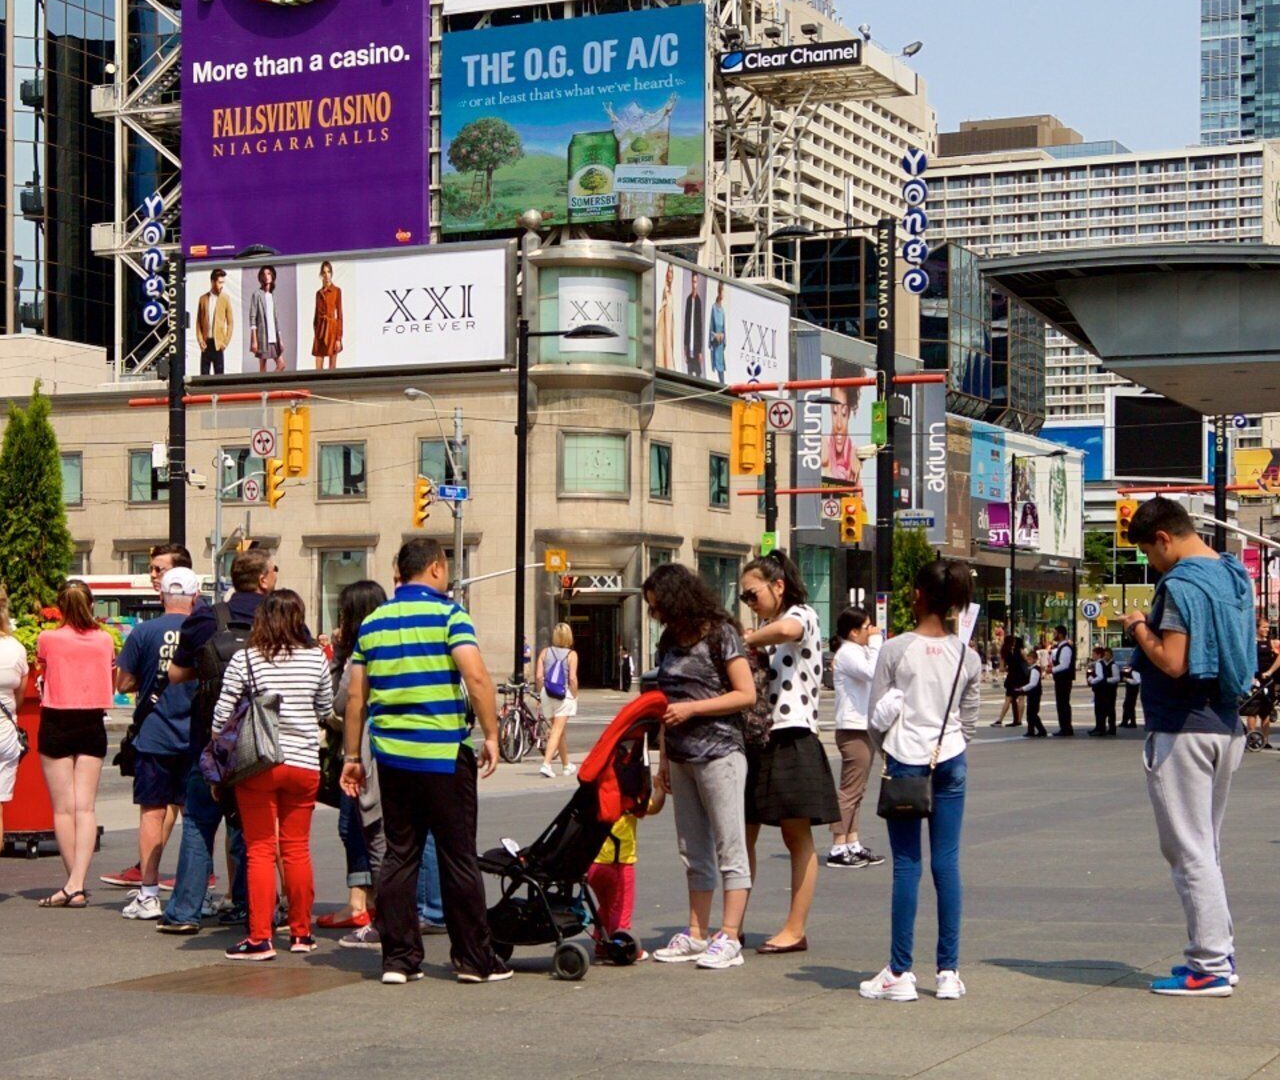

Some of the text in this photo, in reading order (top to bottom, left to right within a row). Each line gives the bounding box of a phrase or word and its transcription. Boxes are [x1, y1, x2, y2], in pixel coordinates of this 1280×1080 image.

[192, 42, 411, 83] More than a casino.
[461, 32, 679, 88] THE O.G. OF A/C
[745, 43, 858, 69] Clear Channel
[469, 73, 673, 108] or at least that's what we've heard
[212, 91, 392, 138] FALLSVIEW CASINO
[213, 127, 390, 157] NIAGARA FALLS
[571, 194, 617, 208] SOMERSBY
[878, 228, 889, 330] DOWNTOWN
[169, 261, 177, 354] DOWNTOWN
[384, 284, 475, 324] XXI
[382, 320, 476, 336] FOREVER
[741, 319, 777, 360] XXI
[797, 390, 822, 470] atrium
[924, 422, 946, 493] atrium
[988, 528, 1040, 542] STYLE
[589, 575, 623, 589] XXI
